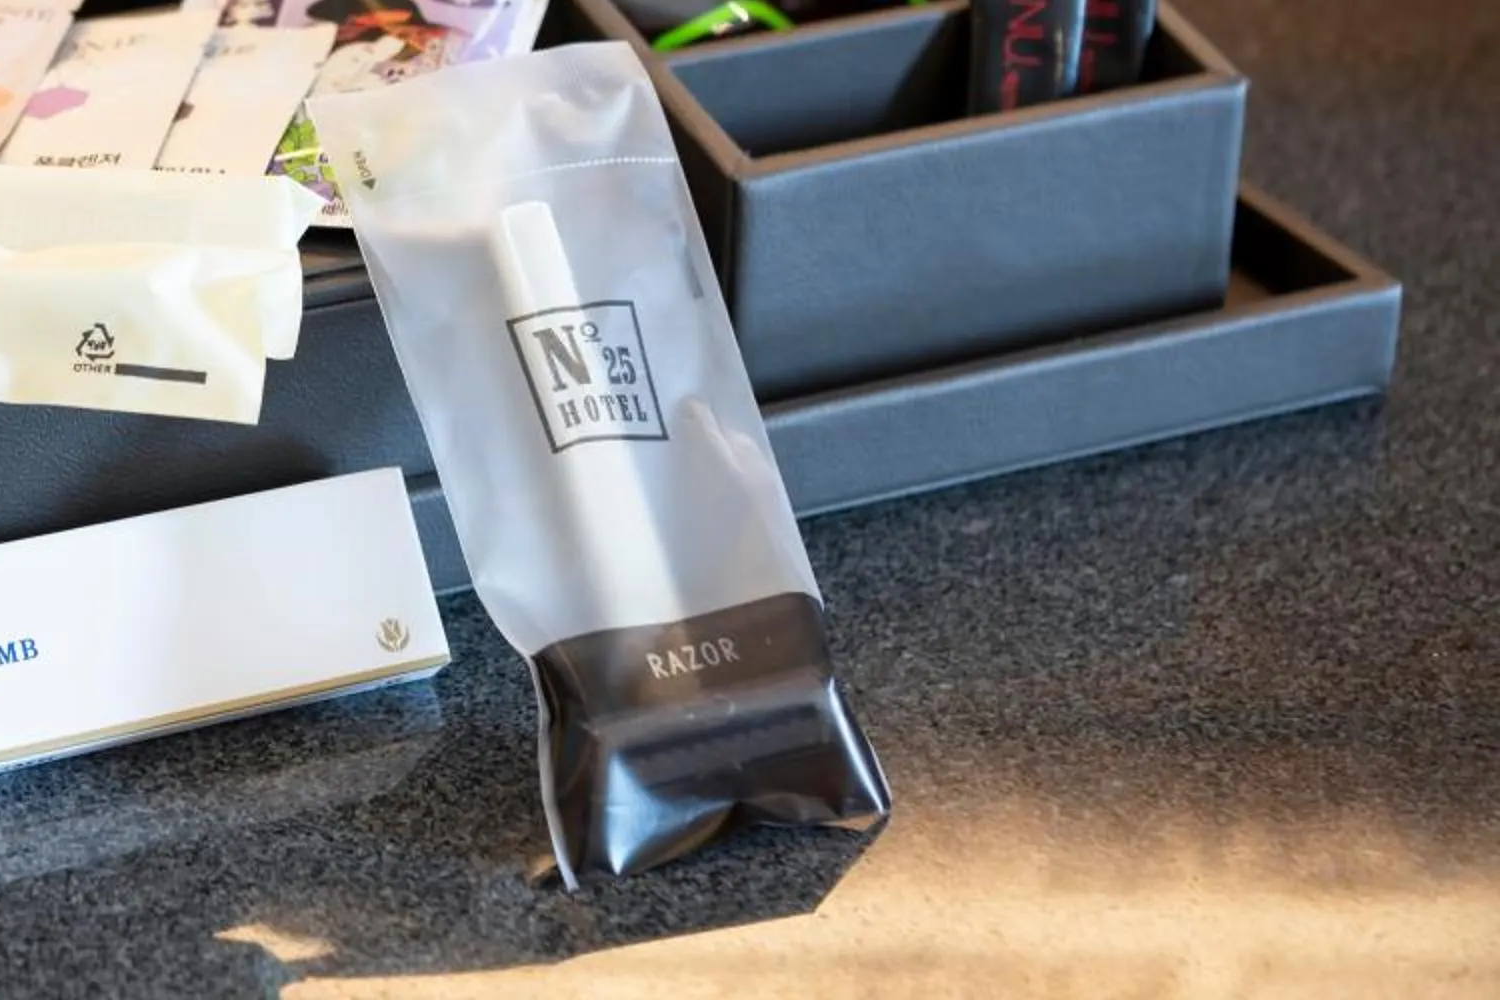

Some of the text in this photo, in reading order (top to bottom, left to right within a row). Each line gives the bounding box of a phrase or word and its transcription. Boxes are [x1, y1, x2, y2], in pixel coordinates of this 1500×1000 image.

[73, 363, 111, 374] OTHER
[558, 394, 649, 429] HOTEL
[646, 637, 740, 679] RAZOR
